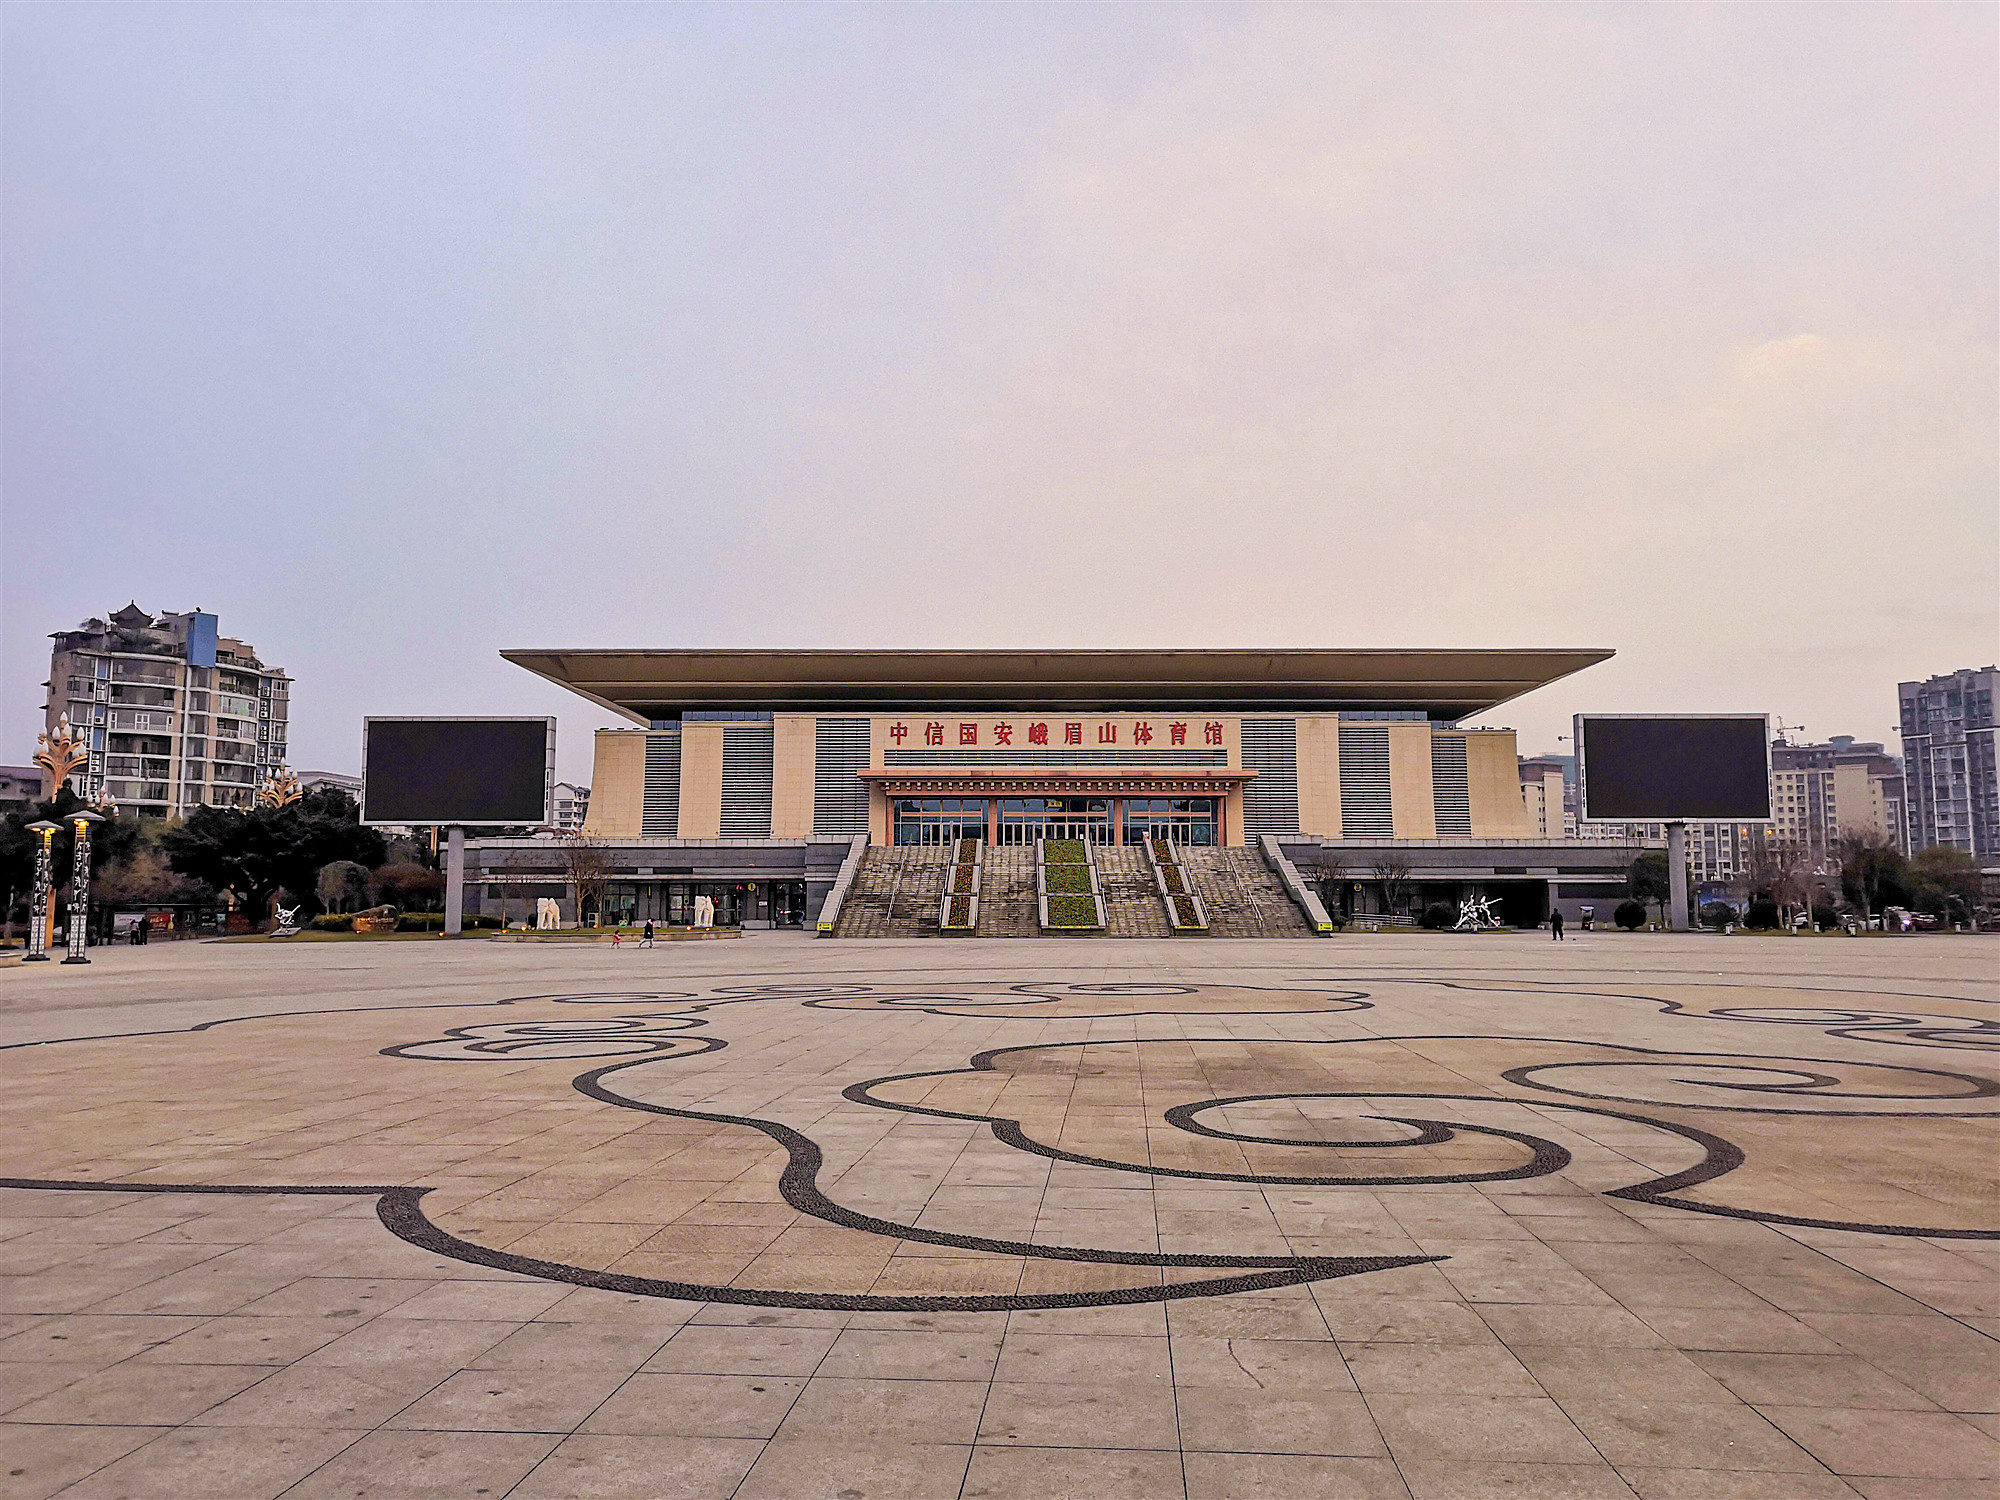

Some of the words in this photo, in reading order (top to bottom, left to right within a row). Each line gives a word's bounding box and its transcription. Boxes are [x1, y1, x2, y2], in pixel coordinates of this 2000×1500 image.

[890, 721, 1223, 745] 中信国安峨眉山体育馆
